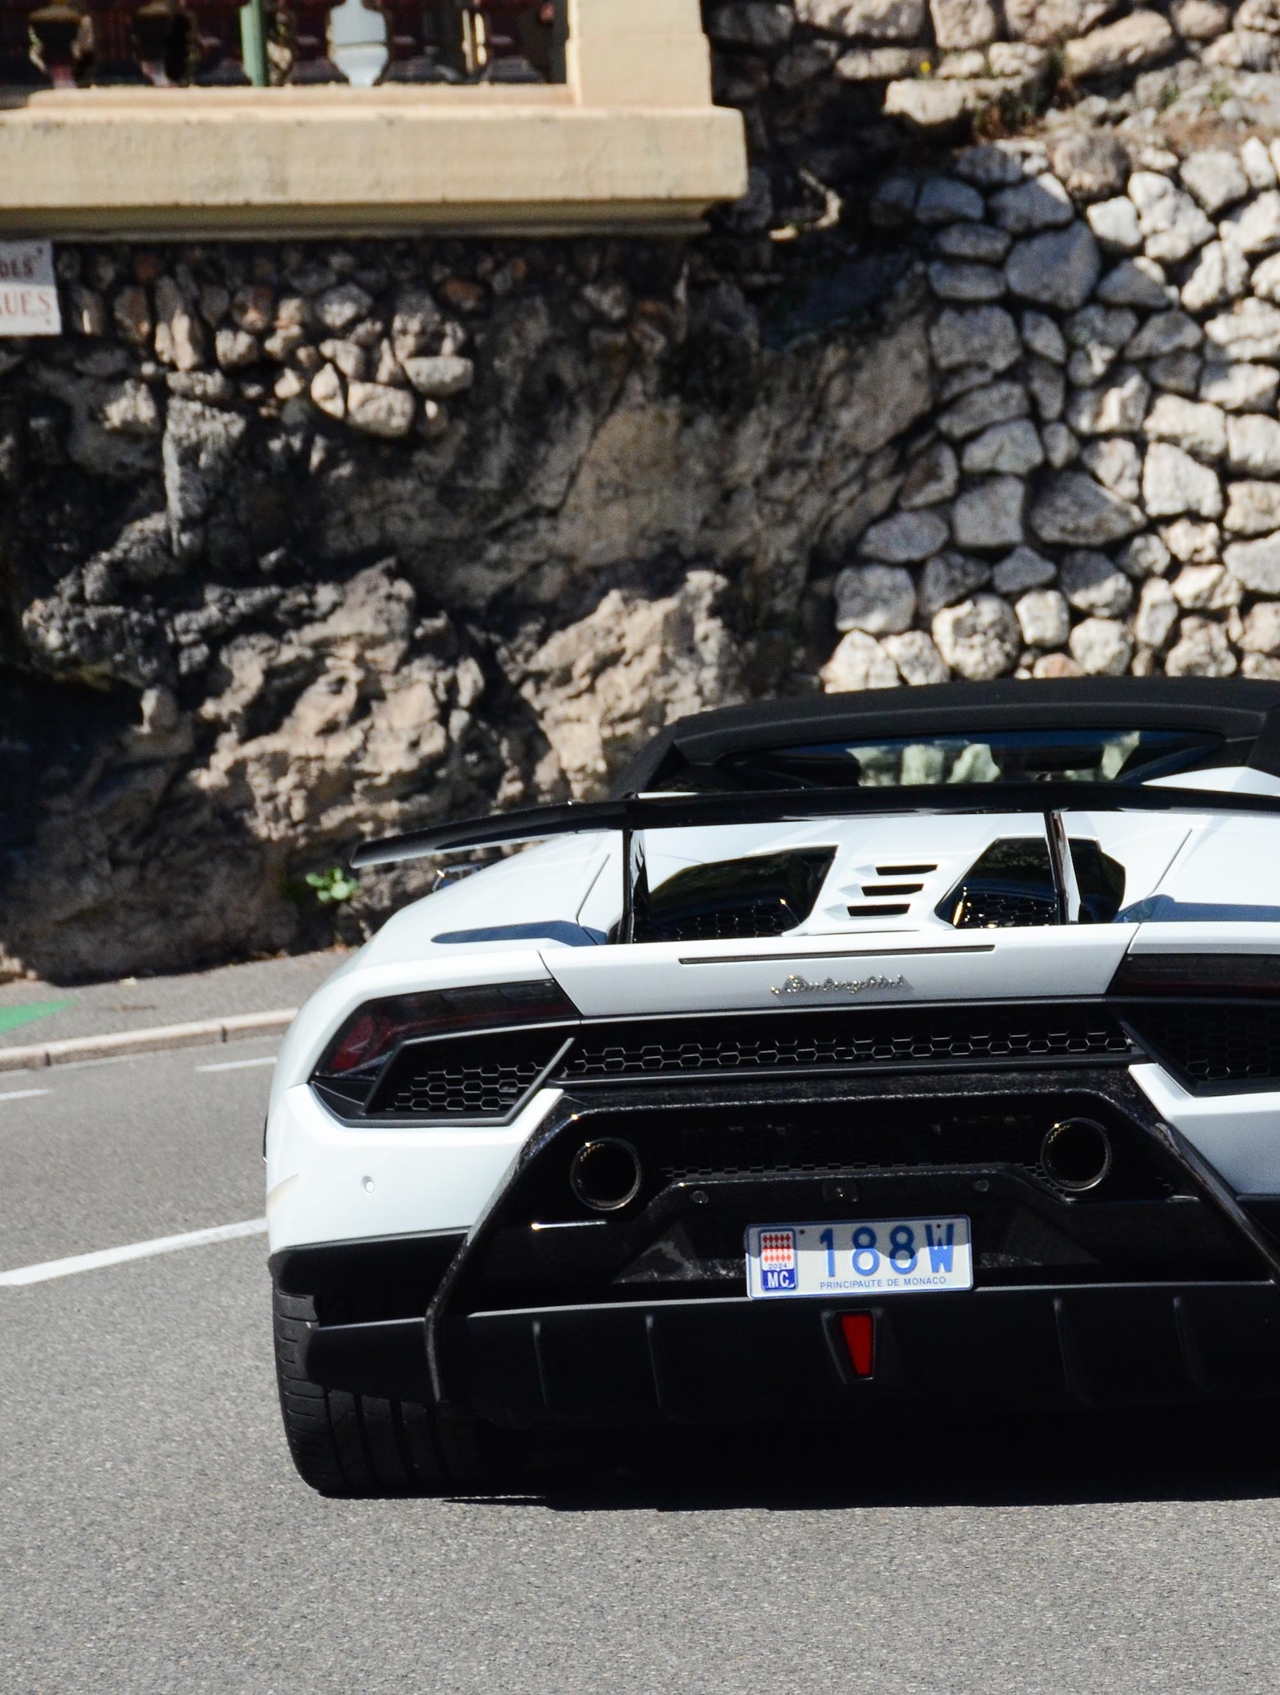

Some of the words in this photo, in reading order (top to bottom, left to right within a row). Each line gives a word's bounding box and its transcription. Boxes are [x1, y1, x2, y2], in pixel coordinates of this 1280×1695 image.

[820, 1223, 955, 1278] 188W
[767, 1271, 790, 1289] MC
[820, 1279, 882, 1290] PRINCIPAUTE
[887, 1278, 899, 1287] DE
[904, 1276, 946, 1286] MONACO
